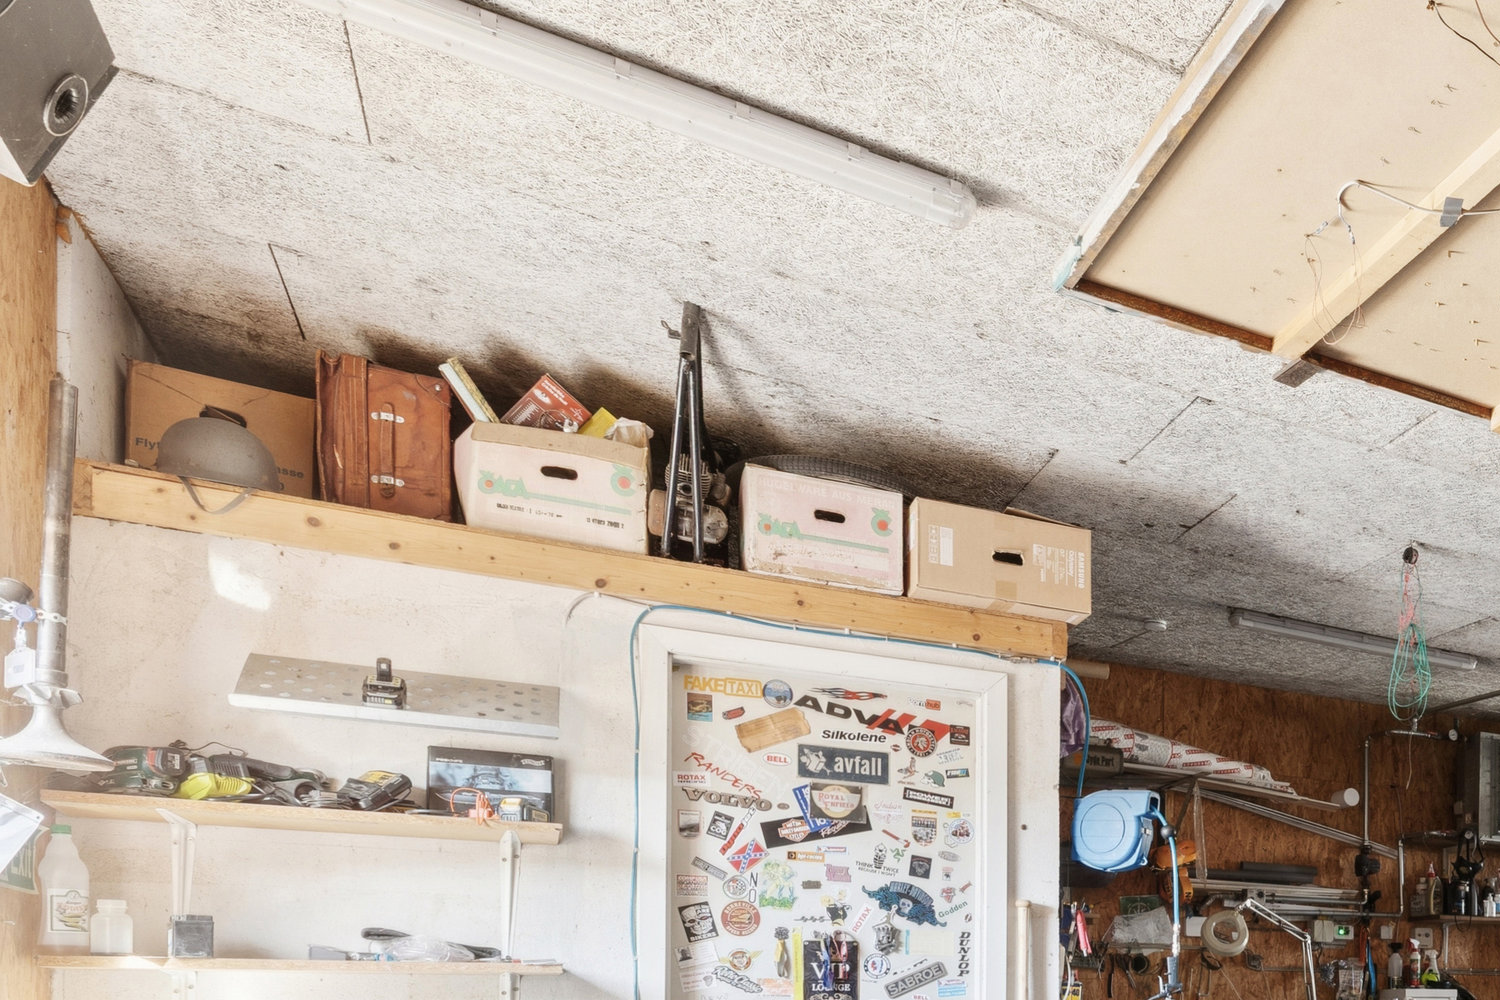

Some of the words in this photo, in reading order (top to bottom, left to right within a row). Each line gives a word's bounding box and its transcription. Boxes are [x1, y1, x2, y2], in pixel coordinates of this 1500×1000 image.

[1077, 551, 1085, 589] SAMSUNG
[793, 694, 936, 737] ADVA
[822, 729, 887, 743] Silkolene
[766, 754, 789, 764] BELL
[834, 755, 882, 777] avfall
[684, 752, 763, 800] RANDERS
[682, 786, 773, 811] VOLVO
[818, 792, 845, 802] ROYAL
[824, 800, 855, 811] ENFIELD
[856, 860, 874, 869] THINK
[883, 866, 899, 874] TWICE
[852, 907, 872, 933] ROTAX
[938, 902, 968, 918] Godden
[957, 931, 971, 977] DUNLOP
[887, 963, 942, 995] SABROE
